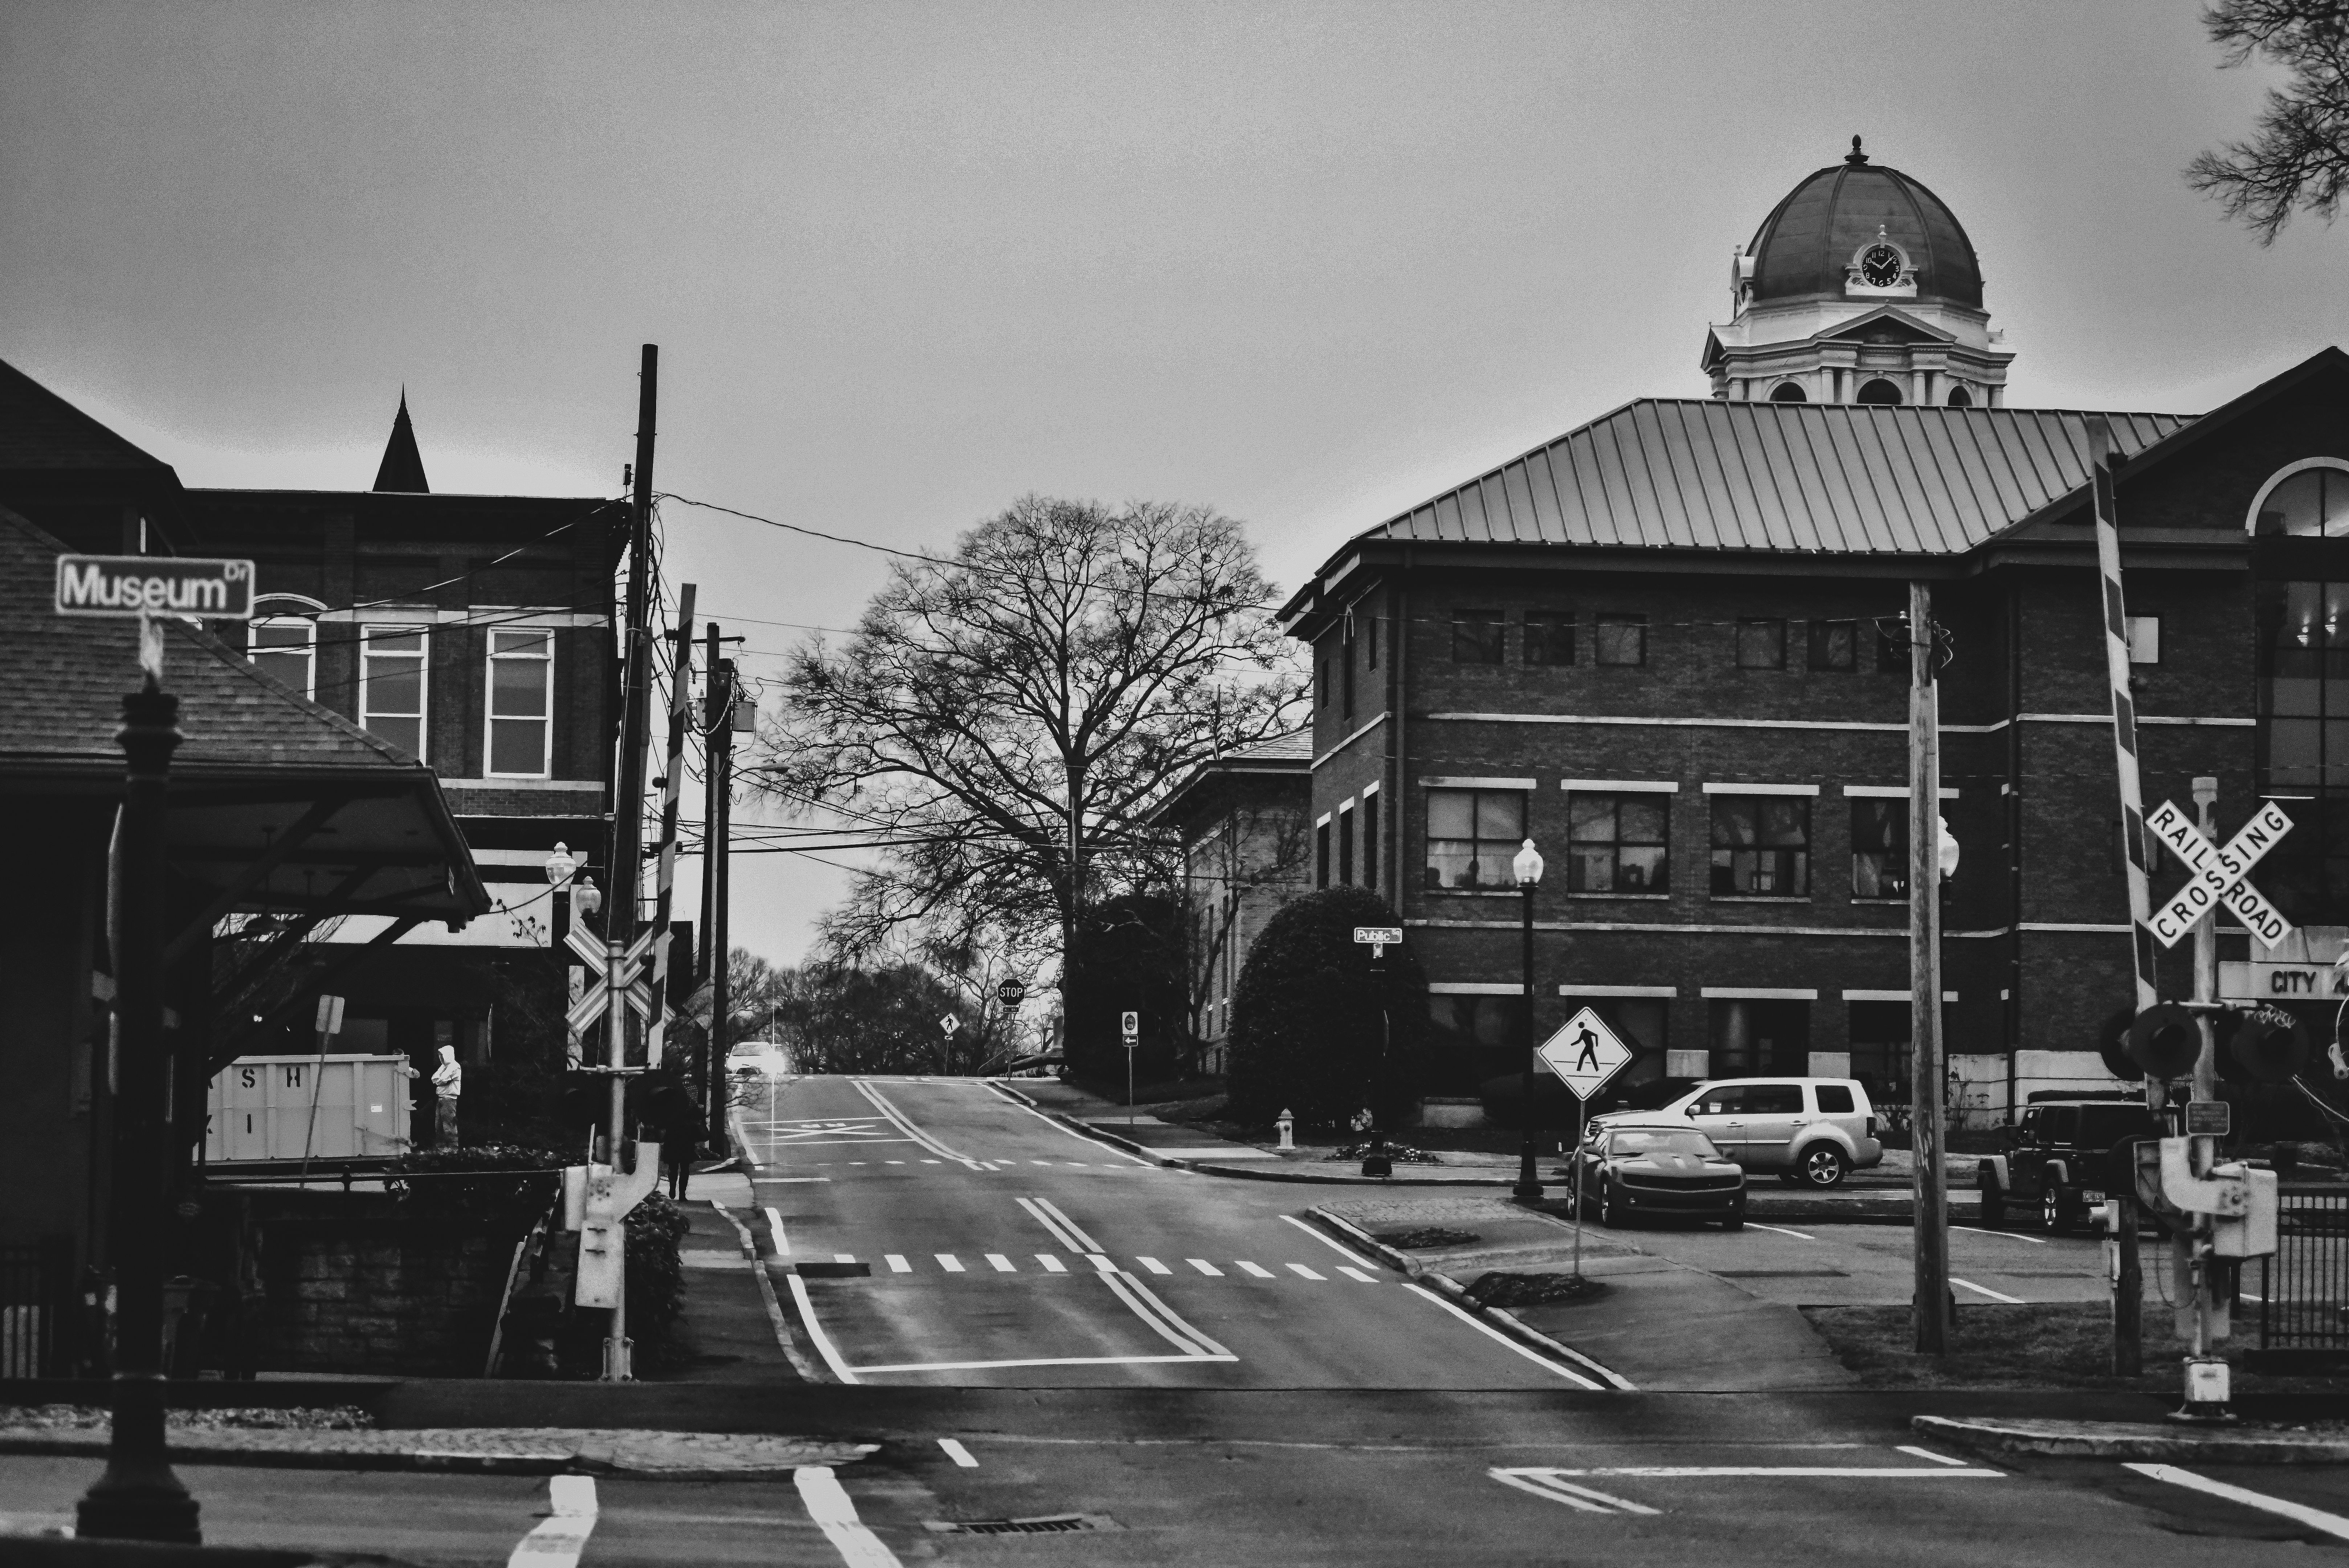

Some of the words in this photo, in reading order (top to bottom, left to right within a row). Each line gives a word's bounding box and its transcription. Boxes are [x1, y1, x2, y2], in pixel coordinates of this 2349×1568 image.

[63, 564, 226, 609] Museum
[2157, 811, 2284, 938] CROSSING
[1357, 930, 1390, 941] Public
[1000, 987, 1023, 997] STOP
[2271, 971, 2317, 993] CITY
